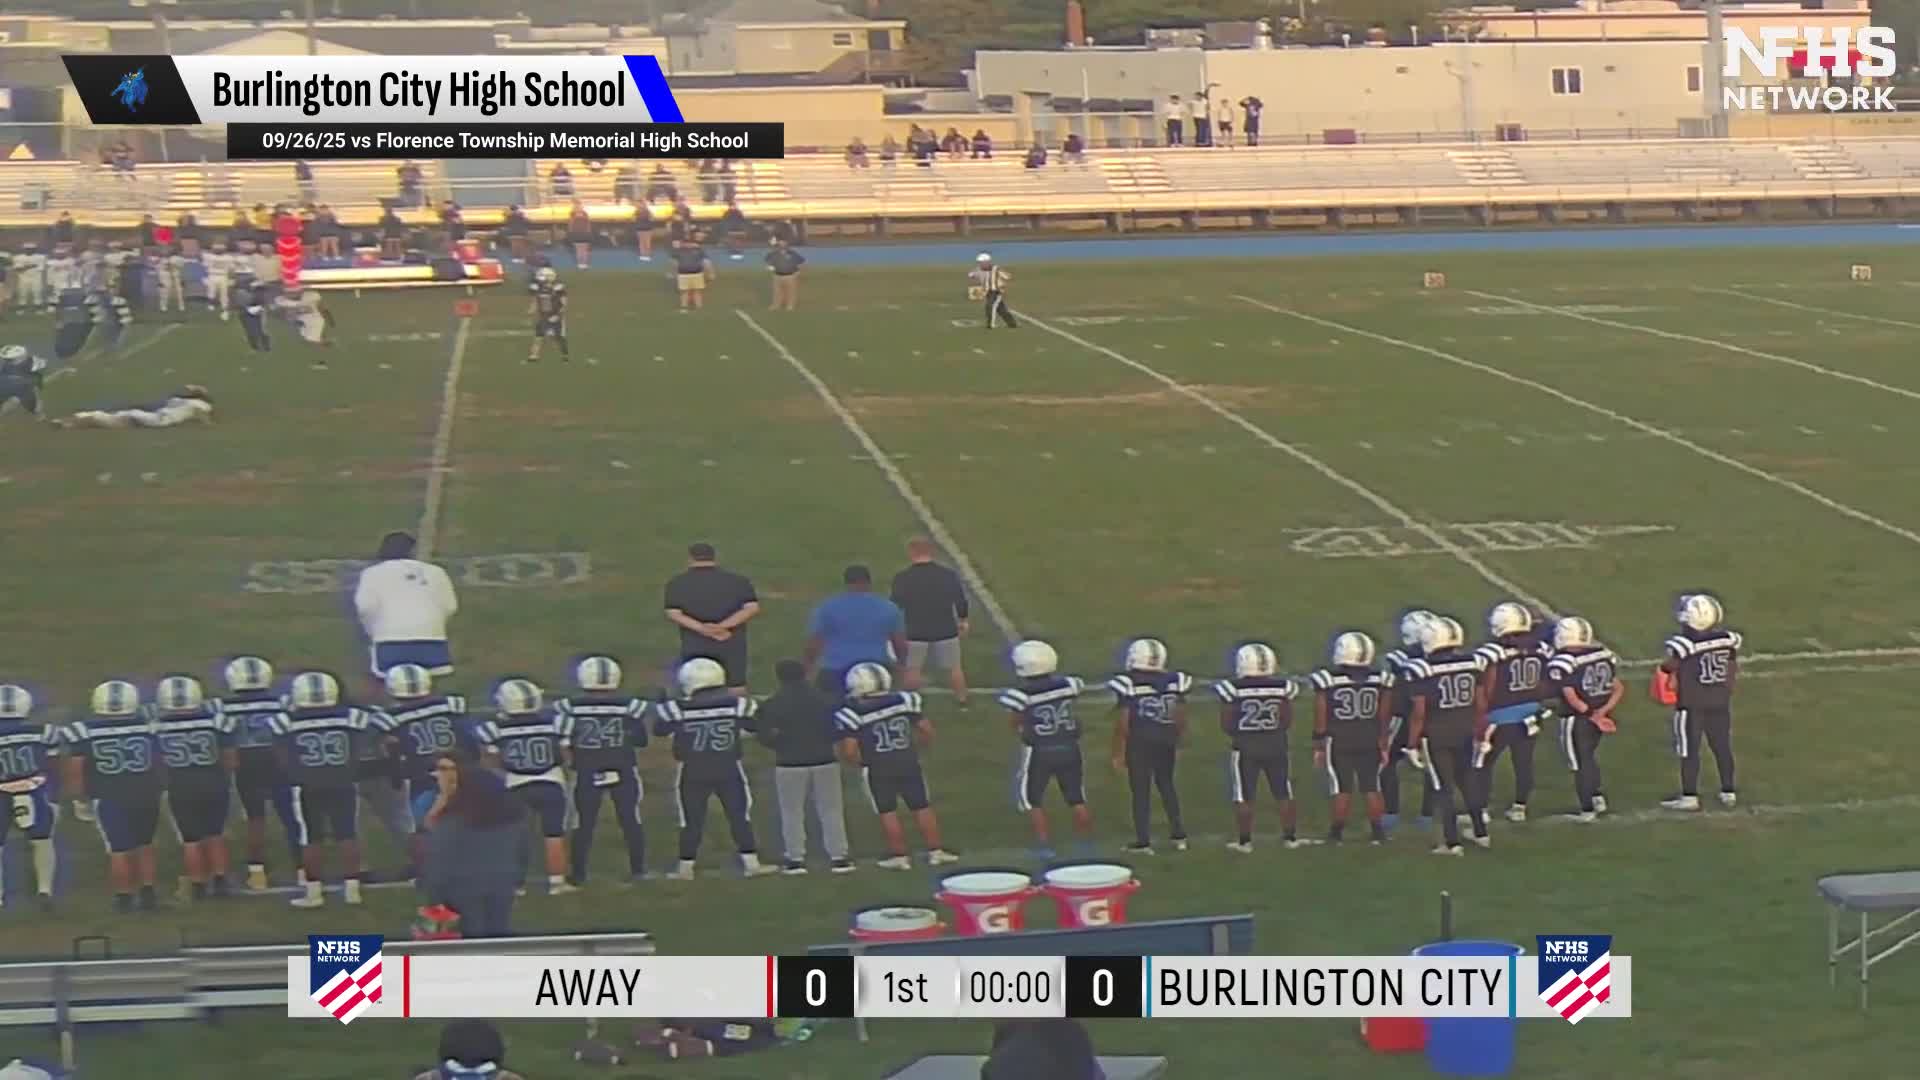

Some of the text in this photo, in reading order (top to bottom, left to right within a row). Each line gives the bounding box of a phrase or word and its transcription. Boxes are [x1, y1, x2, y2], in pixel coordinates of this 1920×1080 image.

[1509, 657, 1541, 691] 10
[1581, 661, 1613, 697] 42
[1700, 651, 1731, 684] 15
[1333, 687, 1379, 721] 30
[1438, 673, 1475, 709] 18
[1034, 703, 1077, 736] 34
[1239, 699, 1281, 732] 23
[160, 731, 218, 767] 53
[297, 731, 349, 767] 33
[409, 717, 457, 756] 16
[576, 717, 624, 750] 24
[685, 720, 735, 752] 75
[873, 717, 911, 753] 13
[92, 738, 152, 775] 53
[507, 736, 553, 770] 40
[978, 906, 1010, 933] G
[1080, 899, 1110, 926] G
